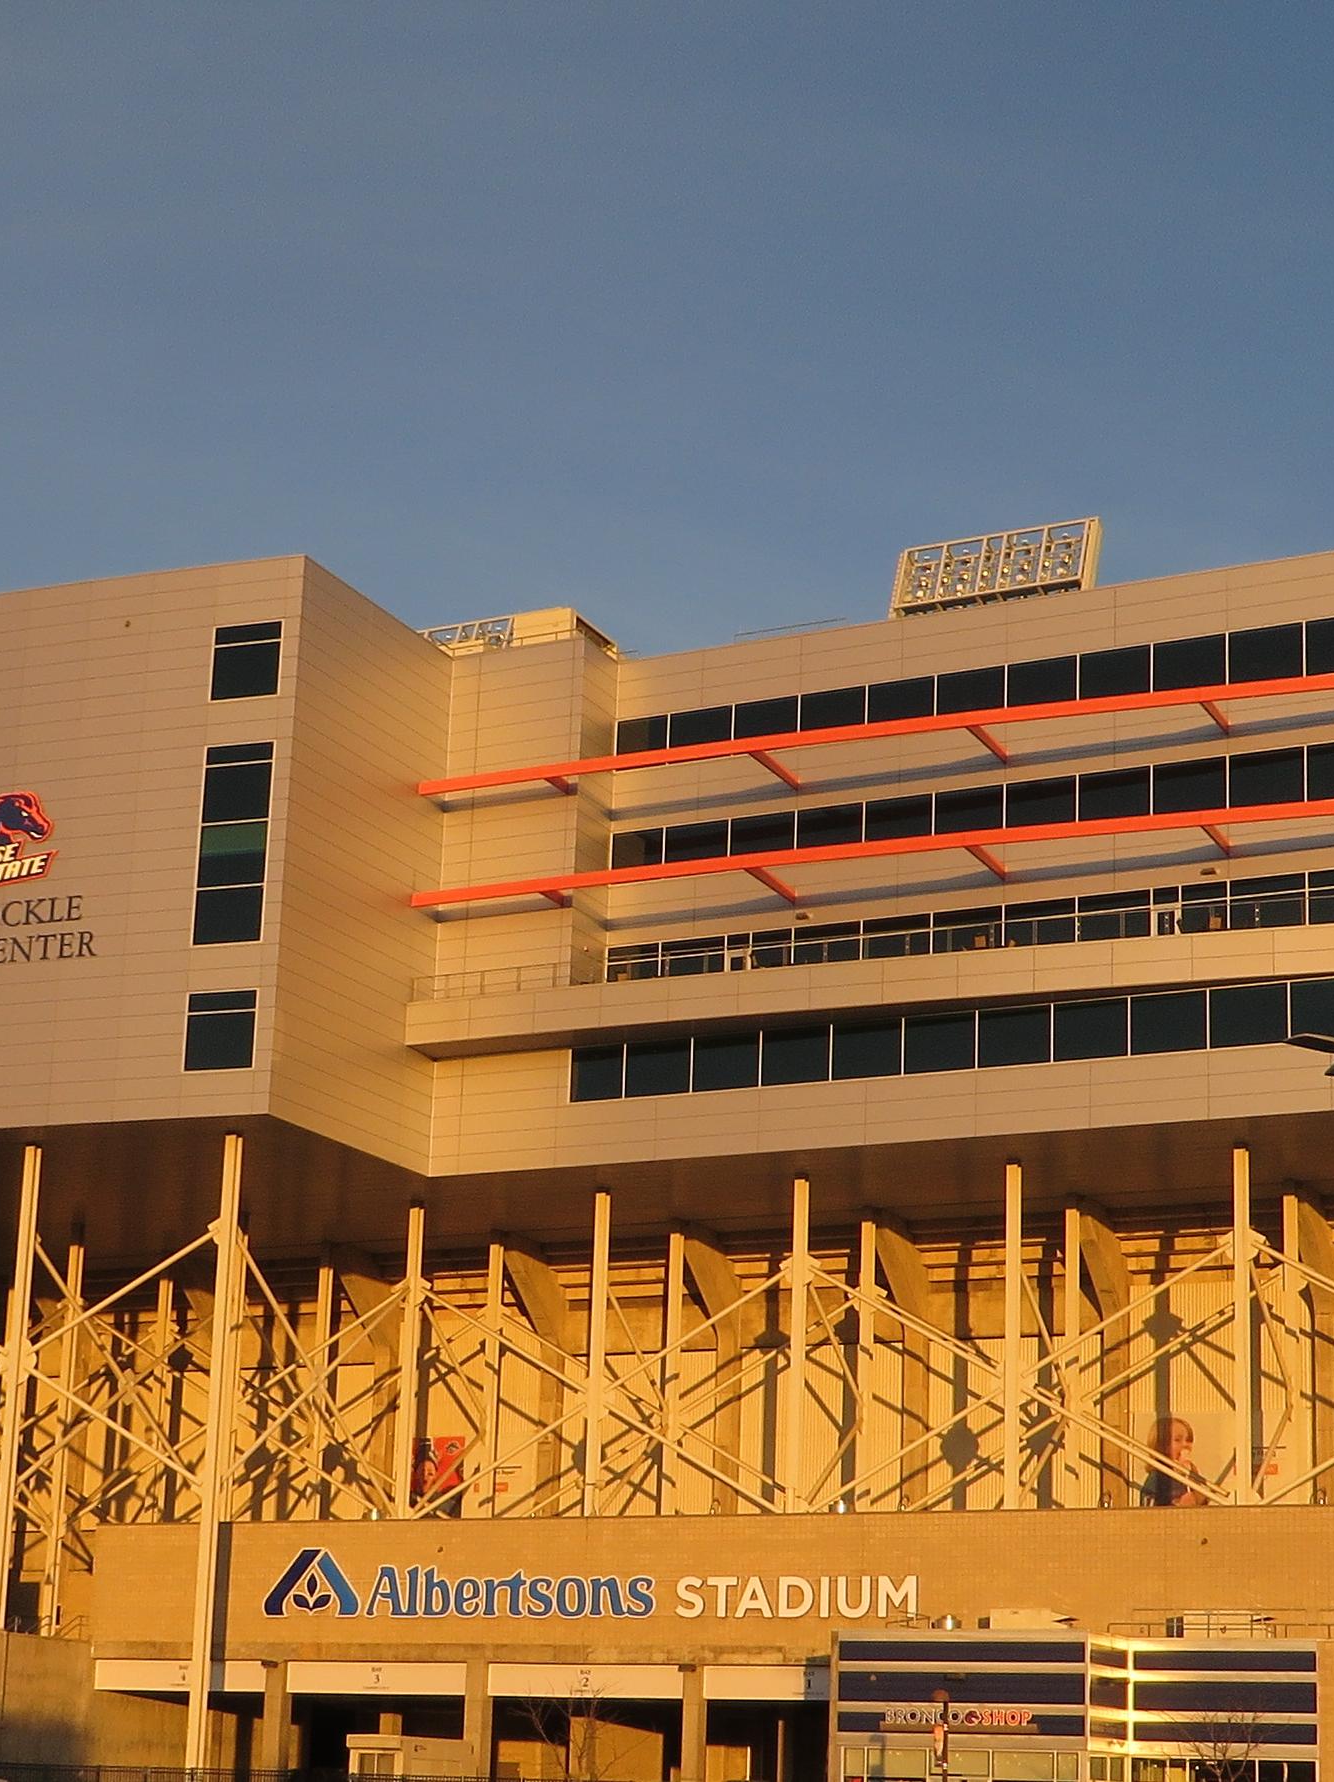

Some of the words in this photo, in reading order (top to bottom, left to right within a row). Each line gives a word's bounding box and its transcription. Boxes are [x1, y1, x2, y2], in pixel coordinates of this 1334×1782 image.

[365, 1564, 656, 1619] Albertsons
[674, 1575, 919, 1618] STADIUM
[373, 1674, 380, 1684] 3
[581, 1677, 589, 1687] 2
[885, 1708, 963, 1725] BRONCO
[982, 1709, 1033, 1726] SHOP
